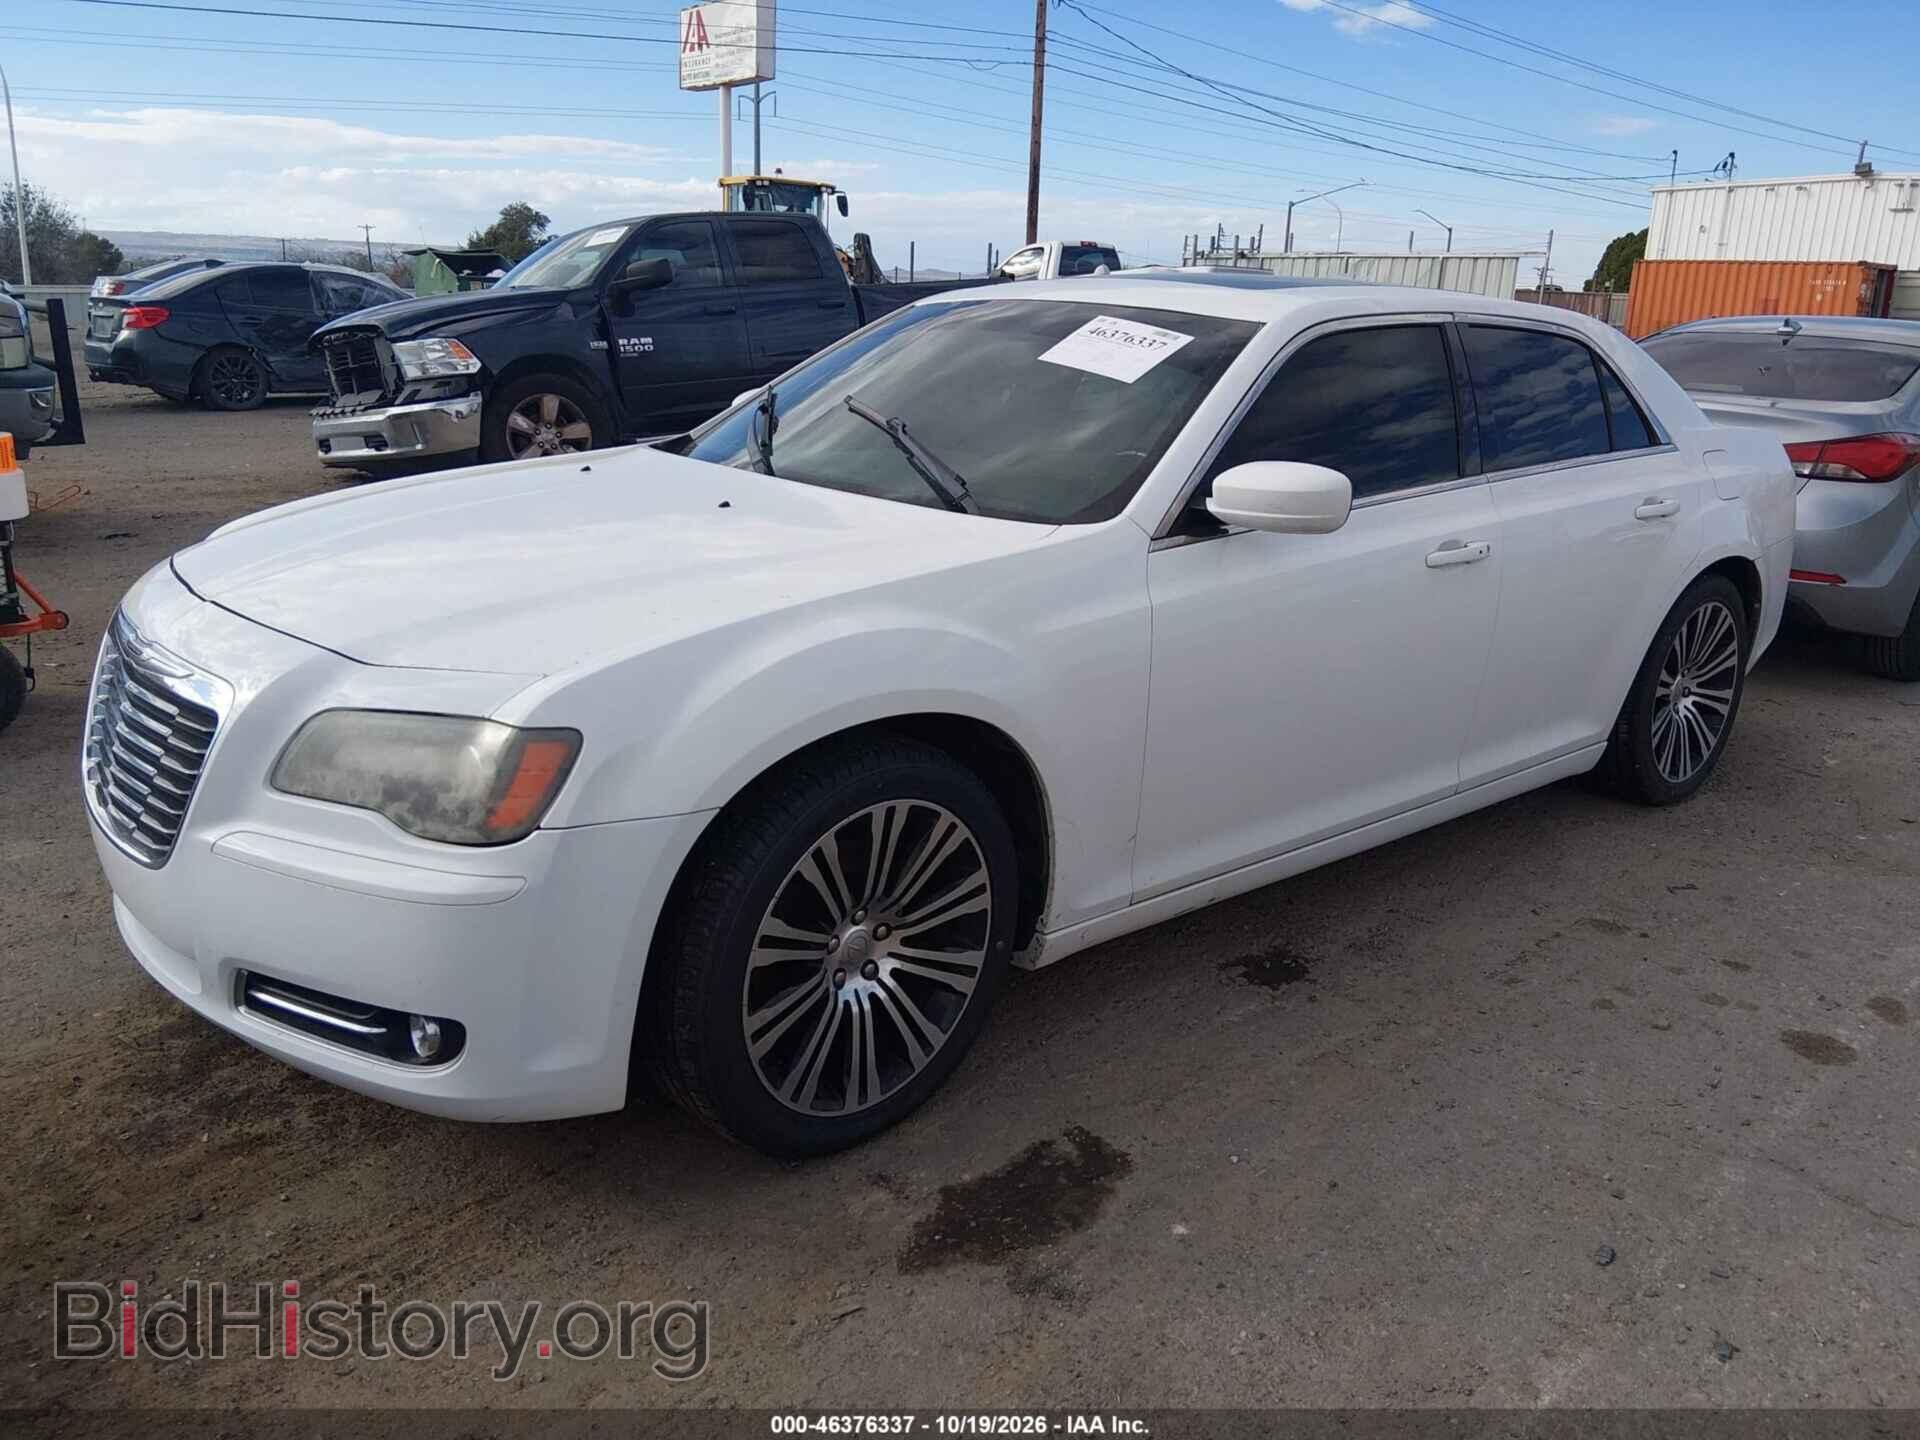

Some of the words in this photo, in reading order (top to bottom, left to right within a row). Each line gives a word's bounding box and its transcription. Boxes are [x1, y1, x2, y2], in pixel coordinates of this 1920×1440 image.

[618, 337, 653, 345] RAM
[1088, 327, 1168, 350] 46376337
[620, 345, 654, 353] 1500
